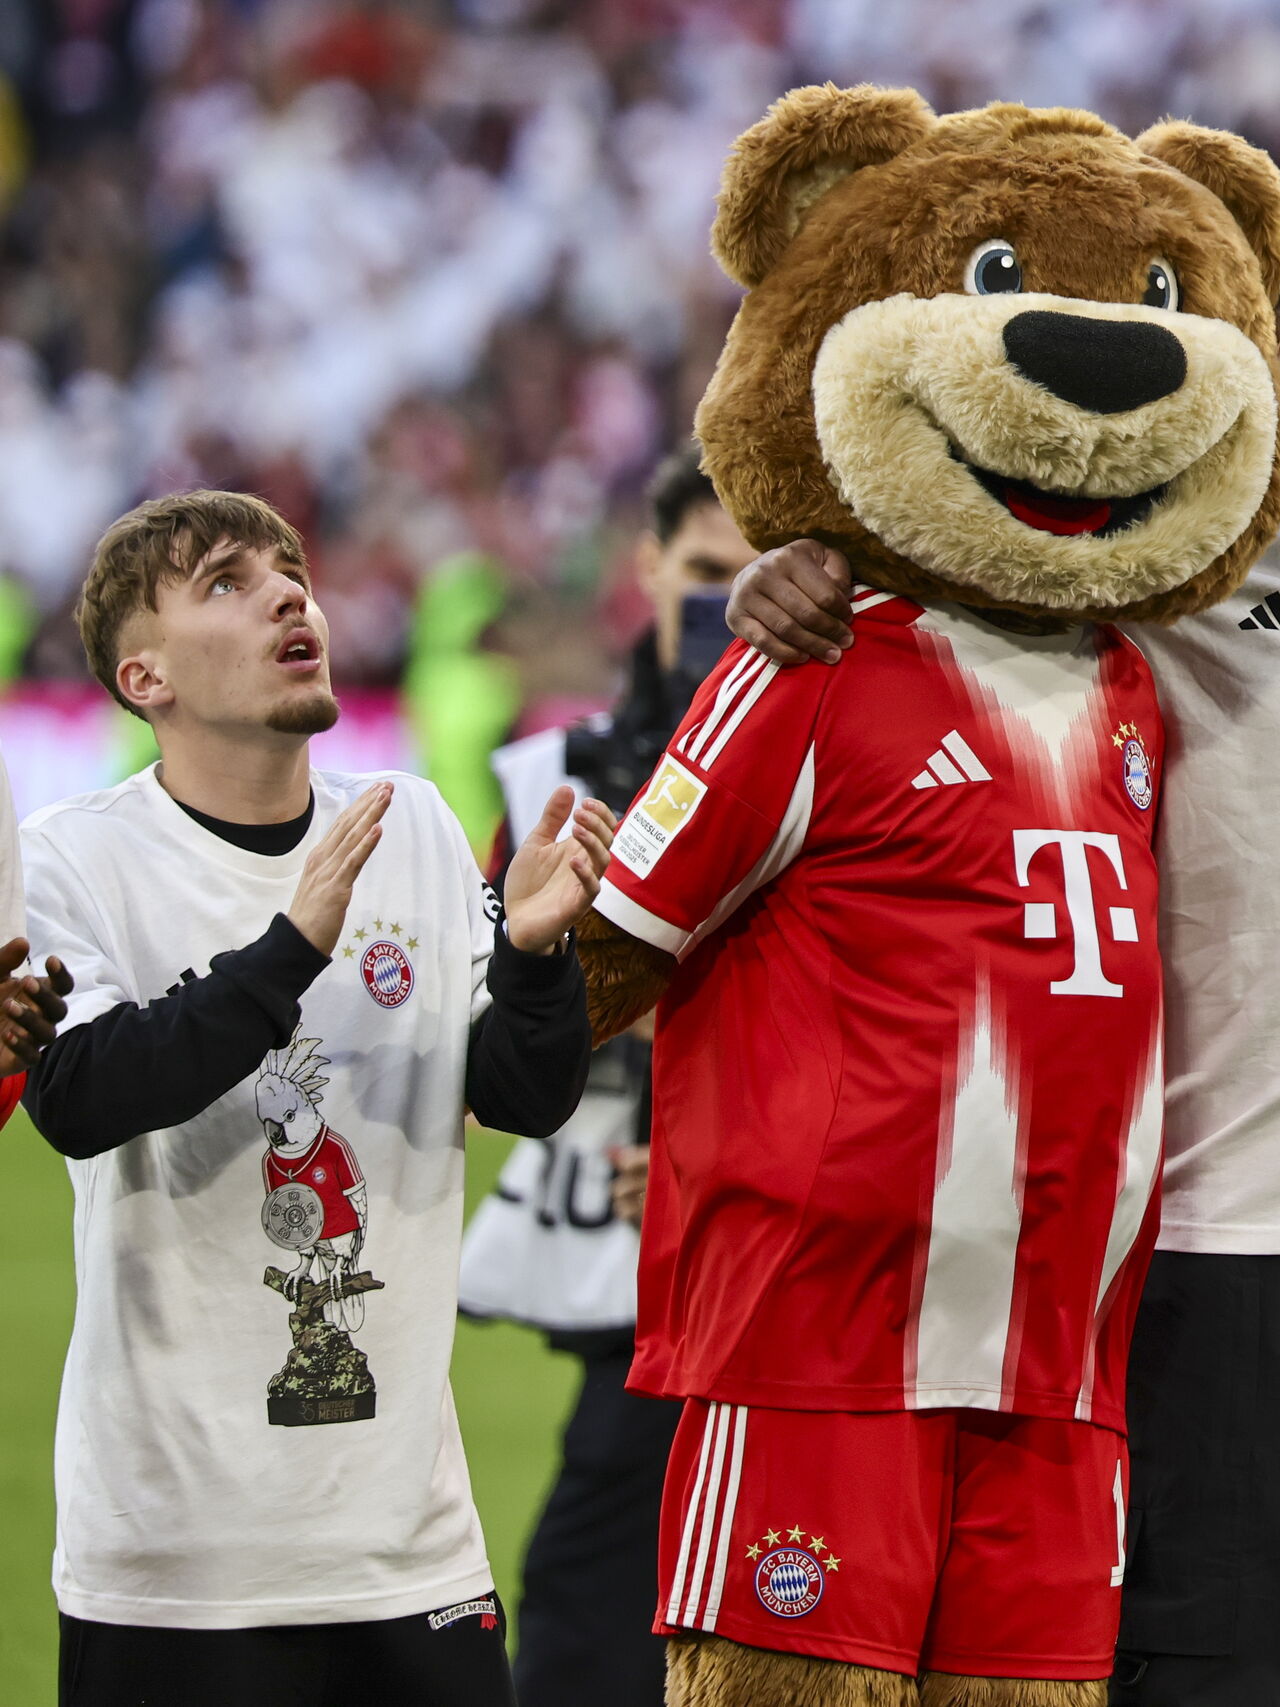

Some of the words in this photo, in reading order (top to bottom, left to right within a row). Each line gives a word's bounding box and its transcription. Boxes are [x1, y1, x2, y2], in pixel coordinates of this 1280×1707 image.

[633, 811, 667, 844] BUNDESLIGA
[1012, 829, 1139, 998] T
[364, 954, 376, 971] FC
[373, 945, 407, 969] BAYERN
[318, 1407, 355, 1421] MEISTER
[762, 1559, 776, 1576] FC
[777, 1552, 820, 1583] BAYERN
